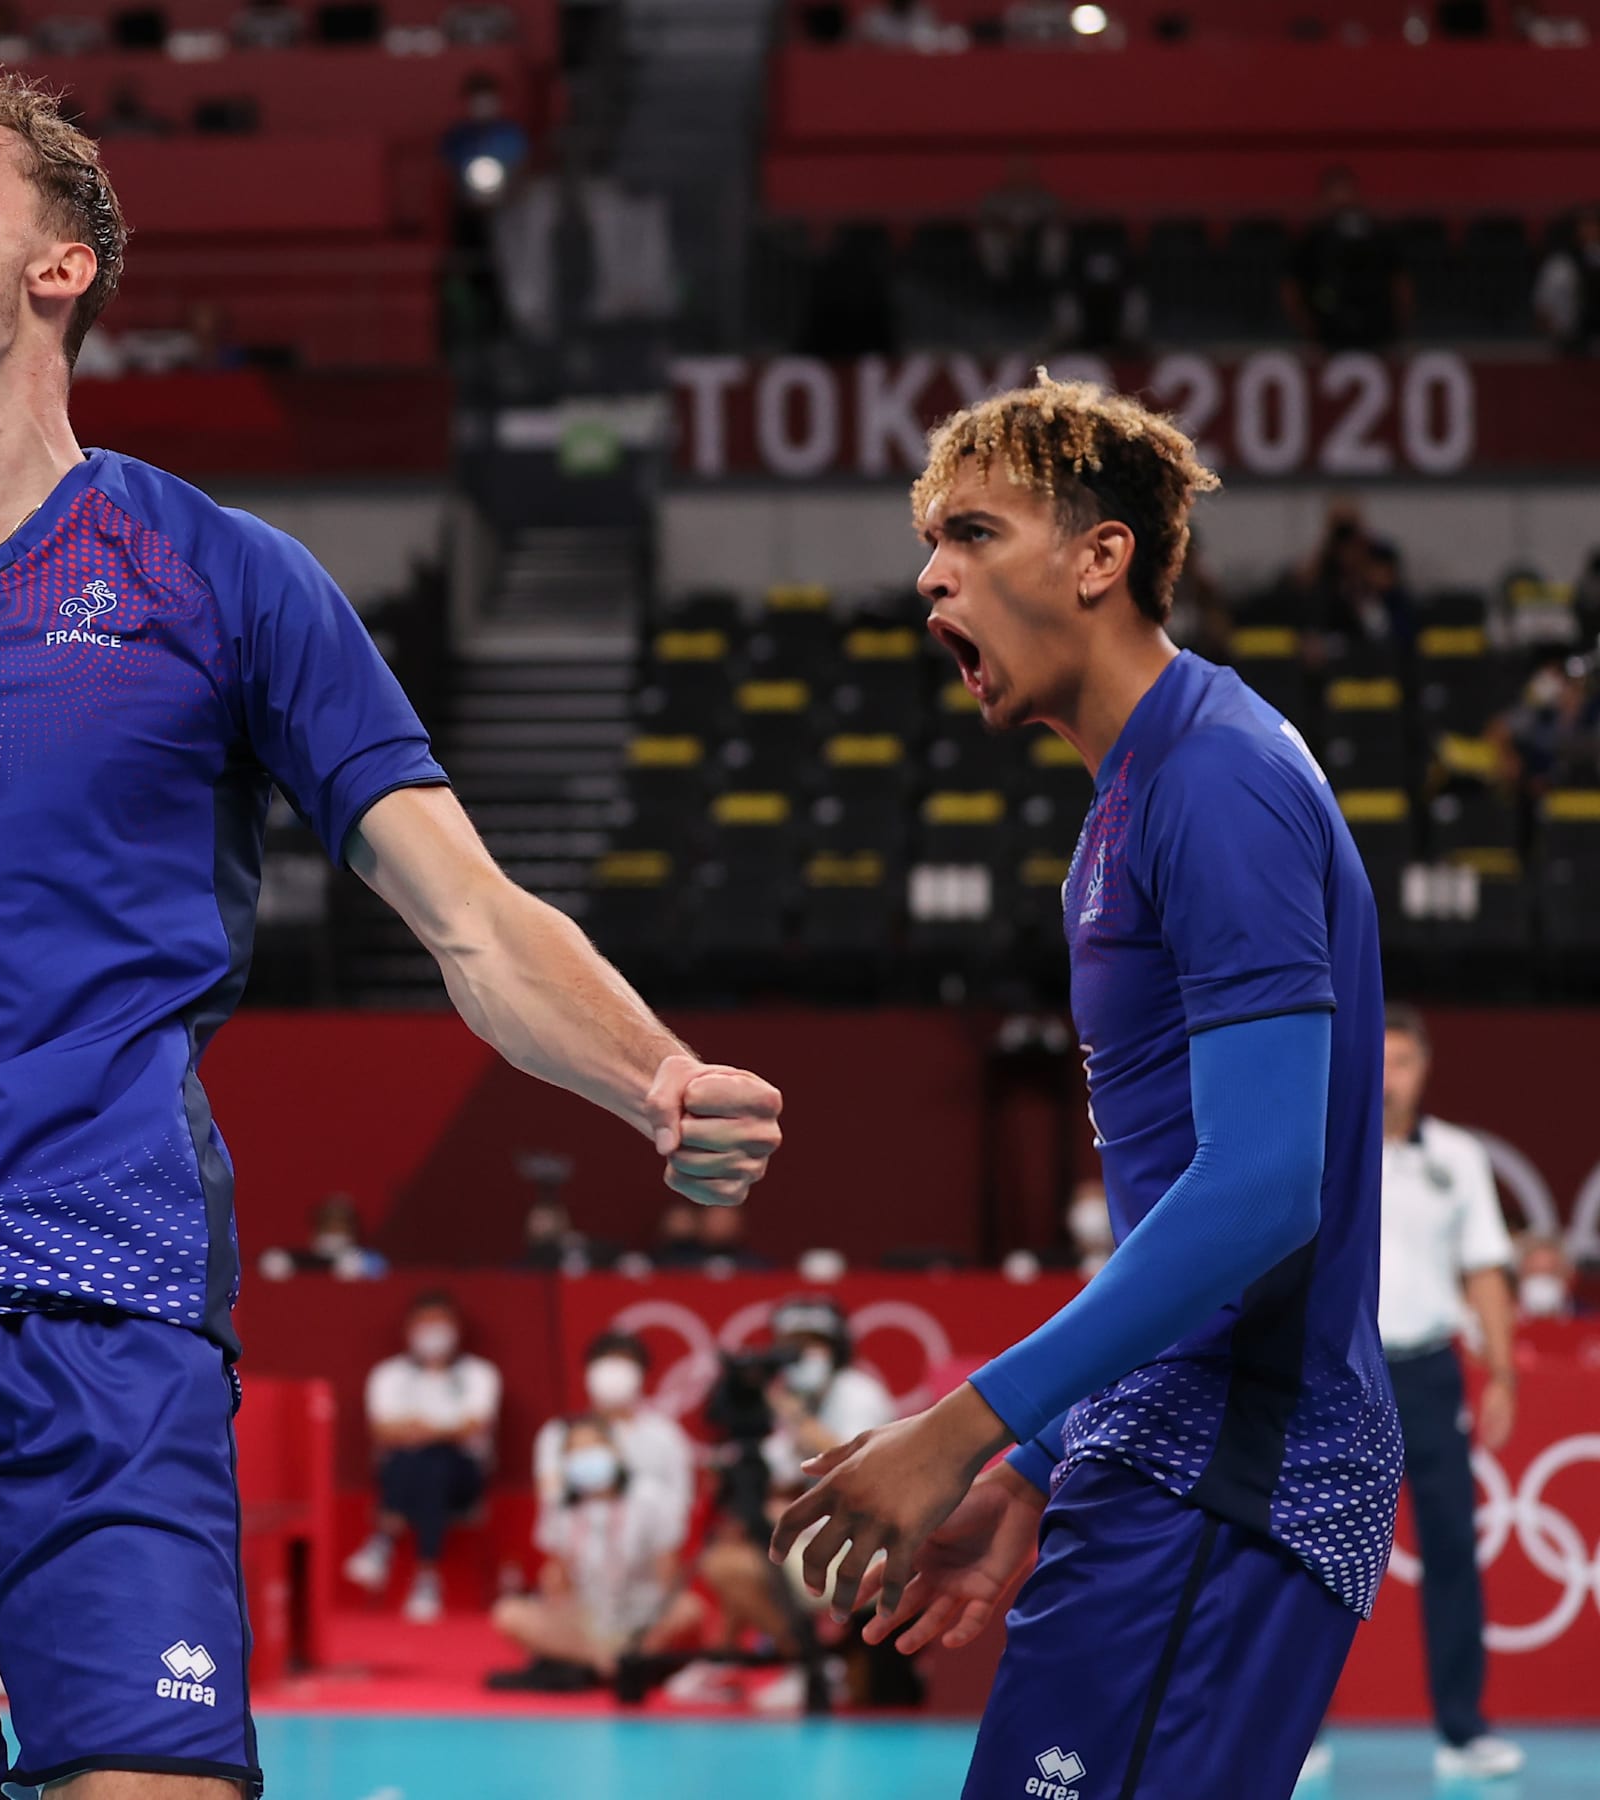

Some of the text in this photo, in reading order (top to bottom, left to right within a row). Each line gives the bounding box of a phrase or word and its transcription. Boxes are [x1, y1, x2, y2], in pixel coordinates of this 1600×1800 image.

[1152, 352, 1476, 474] 2020
[46, 629, 122, 648] FRANCE
[156, 1677, 216, 1707] errea
[1025, 1776, 1080, 1800] errea
